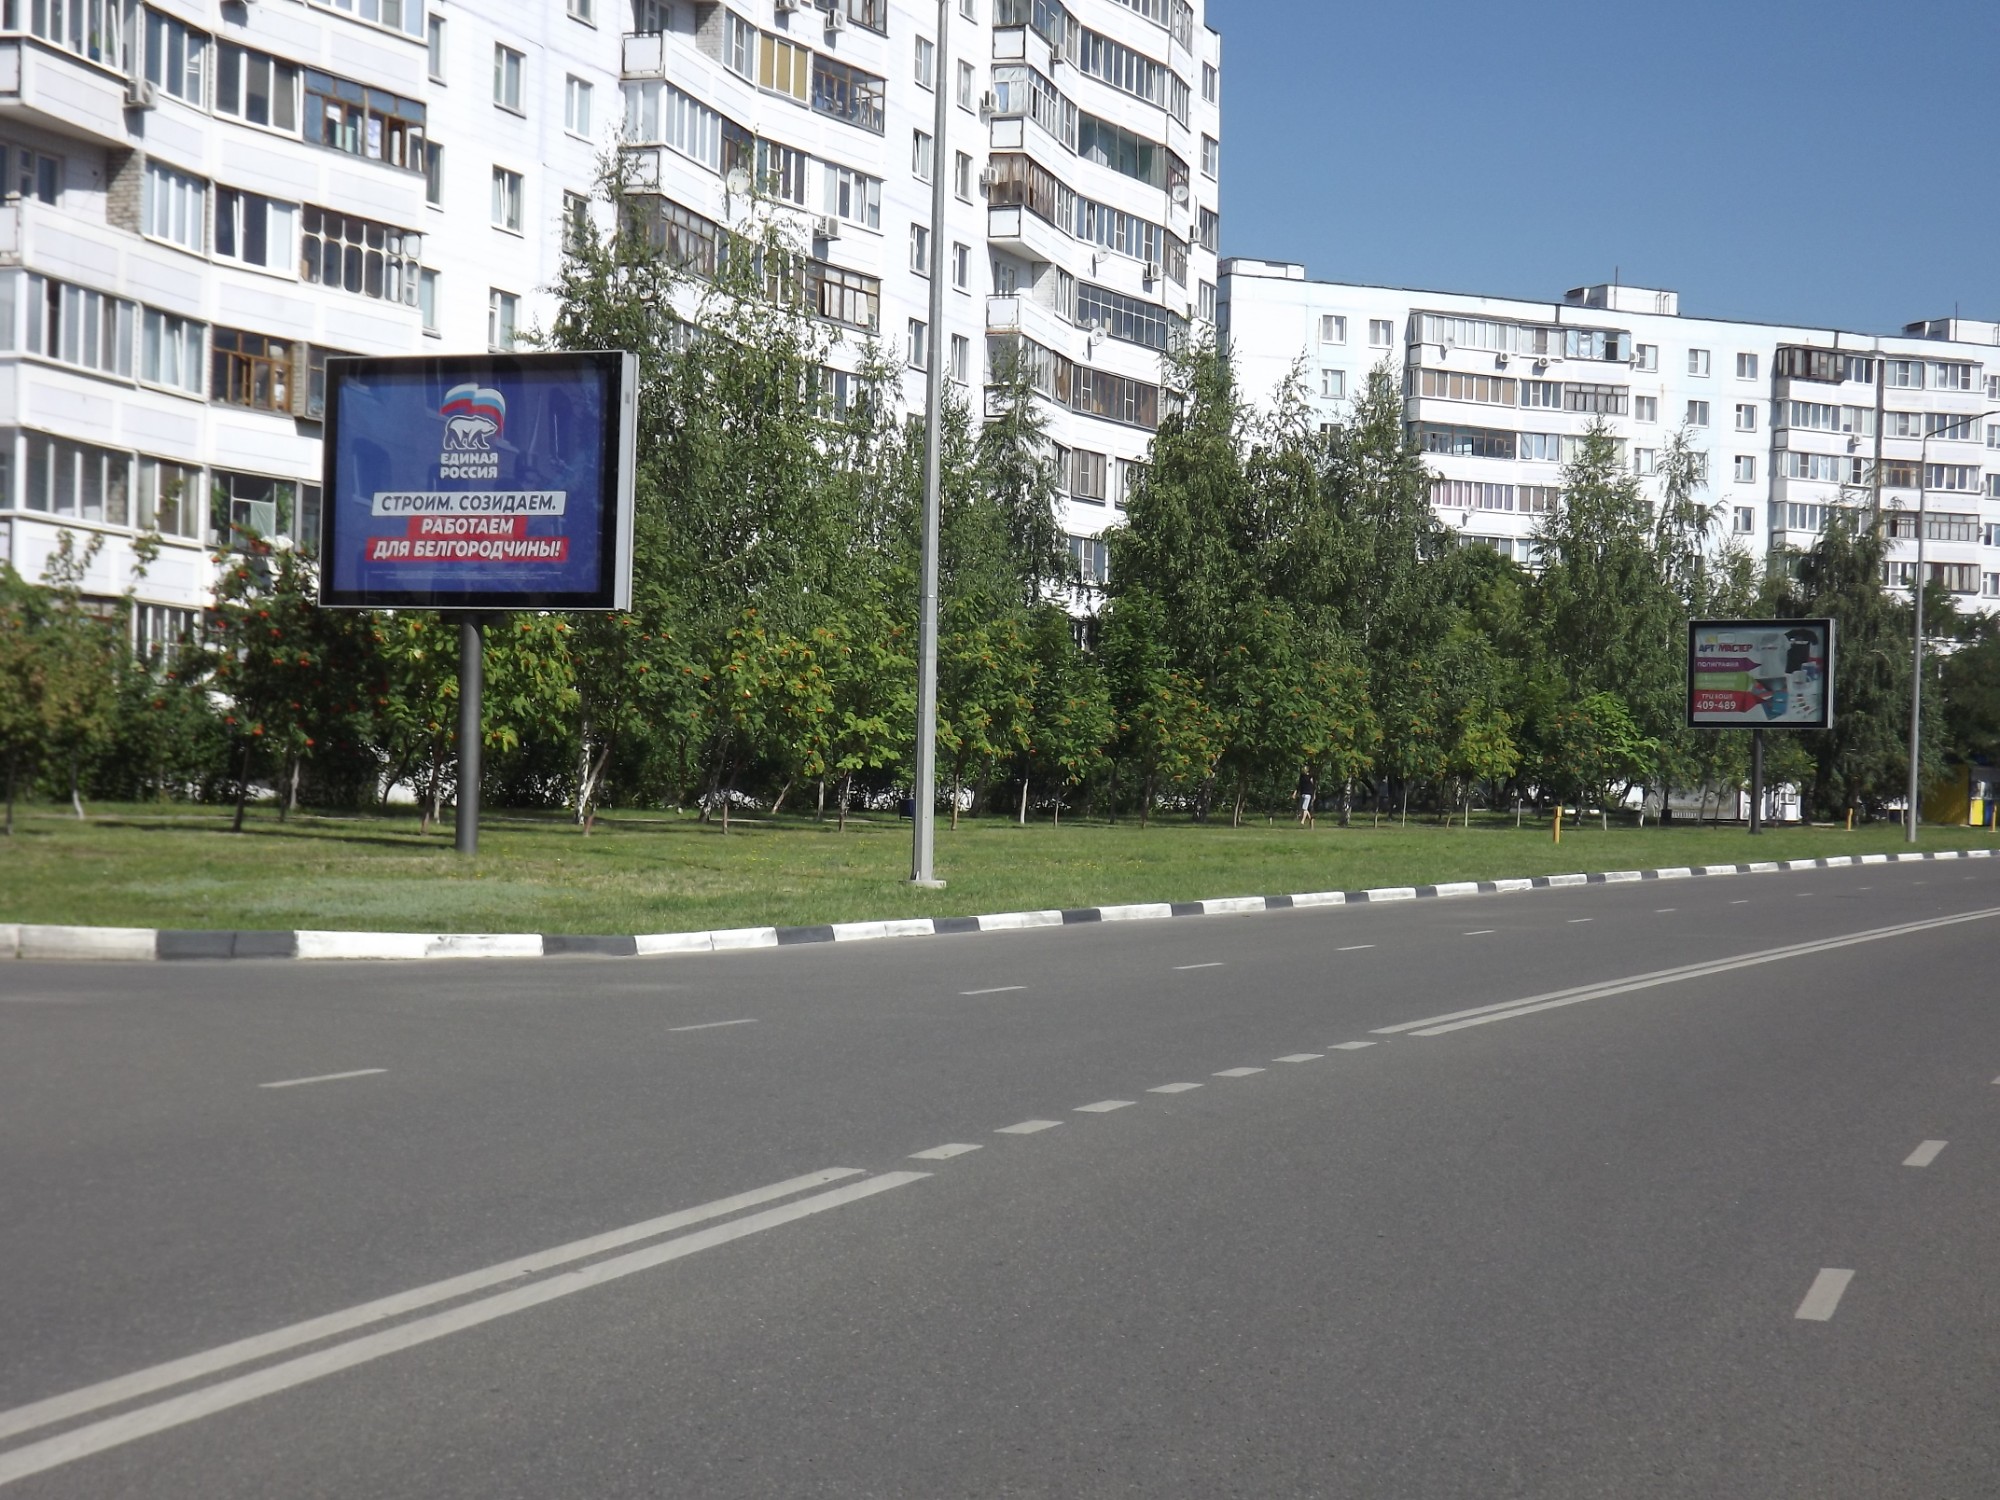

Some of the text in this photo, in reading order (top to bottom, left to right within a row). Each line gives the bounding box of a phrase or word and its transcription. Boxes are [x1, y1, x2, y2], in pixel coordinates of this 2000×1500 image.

[440, 452, 498, 465] ЕДИНАЯ
[440, 466, 498, 479] РОССИЯ
[381, 494, 557, 513] СТРОИМ. СОЗИДАЕМ.
[421, 518, 515, 535] РАБОТАЕМ
[373, 541, 561, 560] ДЛЯ БЕЛГОРОДЧИНЫ!
[1699, 644, 1715, 652] АРТ
[1719, 644, 1753, 652] МАСТЕР
[1696, 701, 1736, 710] 409-489
